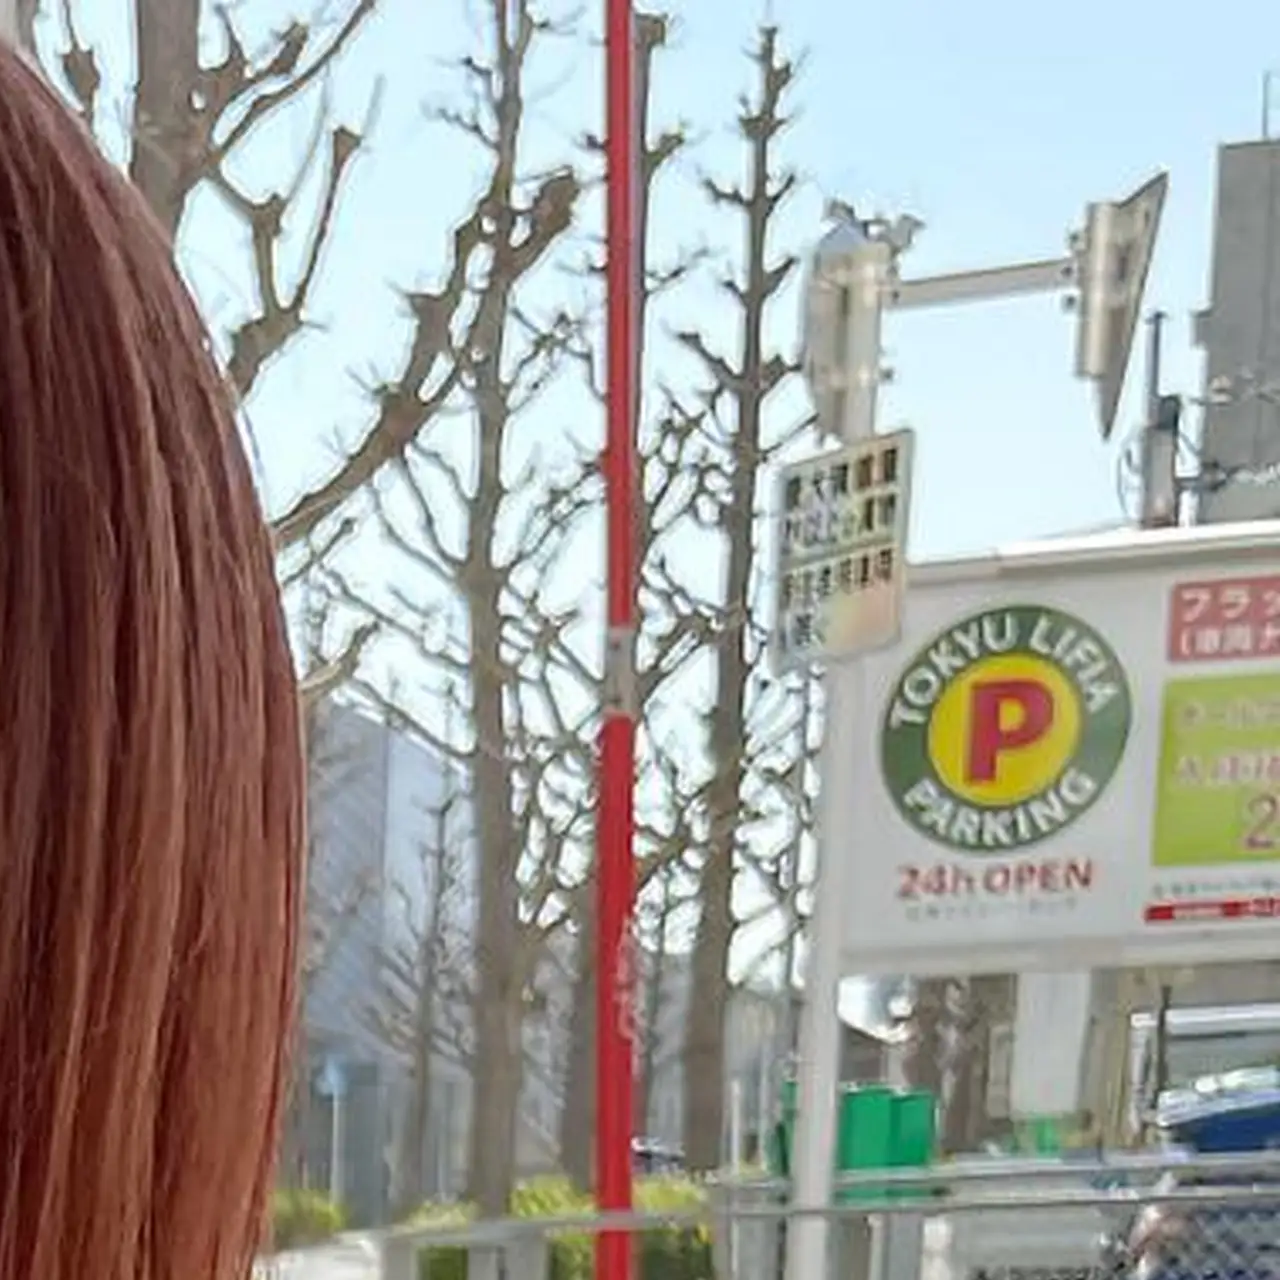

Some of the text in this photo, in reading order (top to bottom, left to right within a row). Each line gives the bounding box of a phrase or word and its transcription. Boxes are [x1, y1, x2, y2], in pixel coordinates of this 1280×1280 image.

[890, 611, 1119, 729] TOKYU LIFIA
[962, 677, 1055, 786] P
[903, 766, 1097, 846] PARKING
[982, 856, 1093, 895] OPEN
